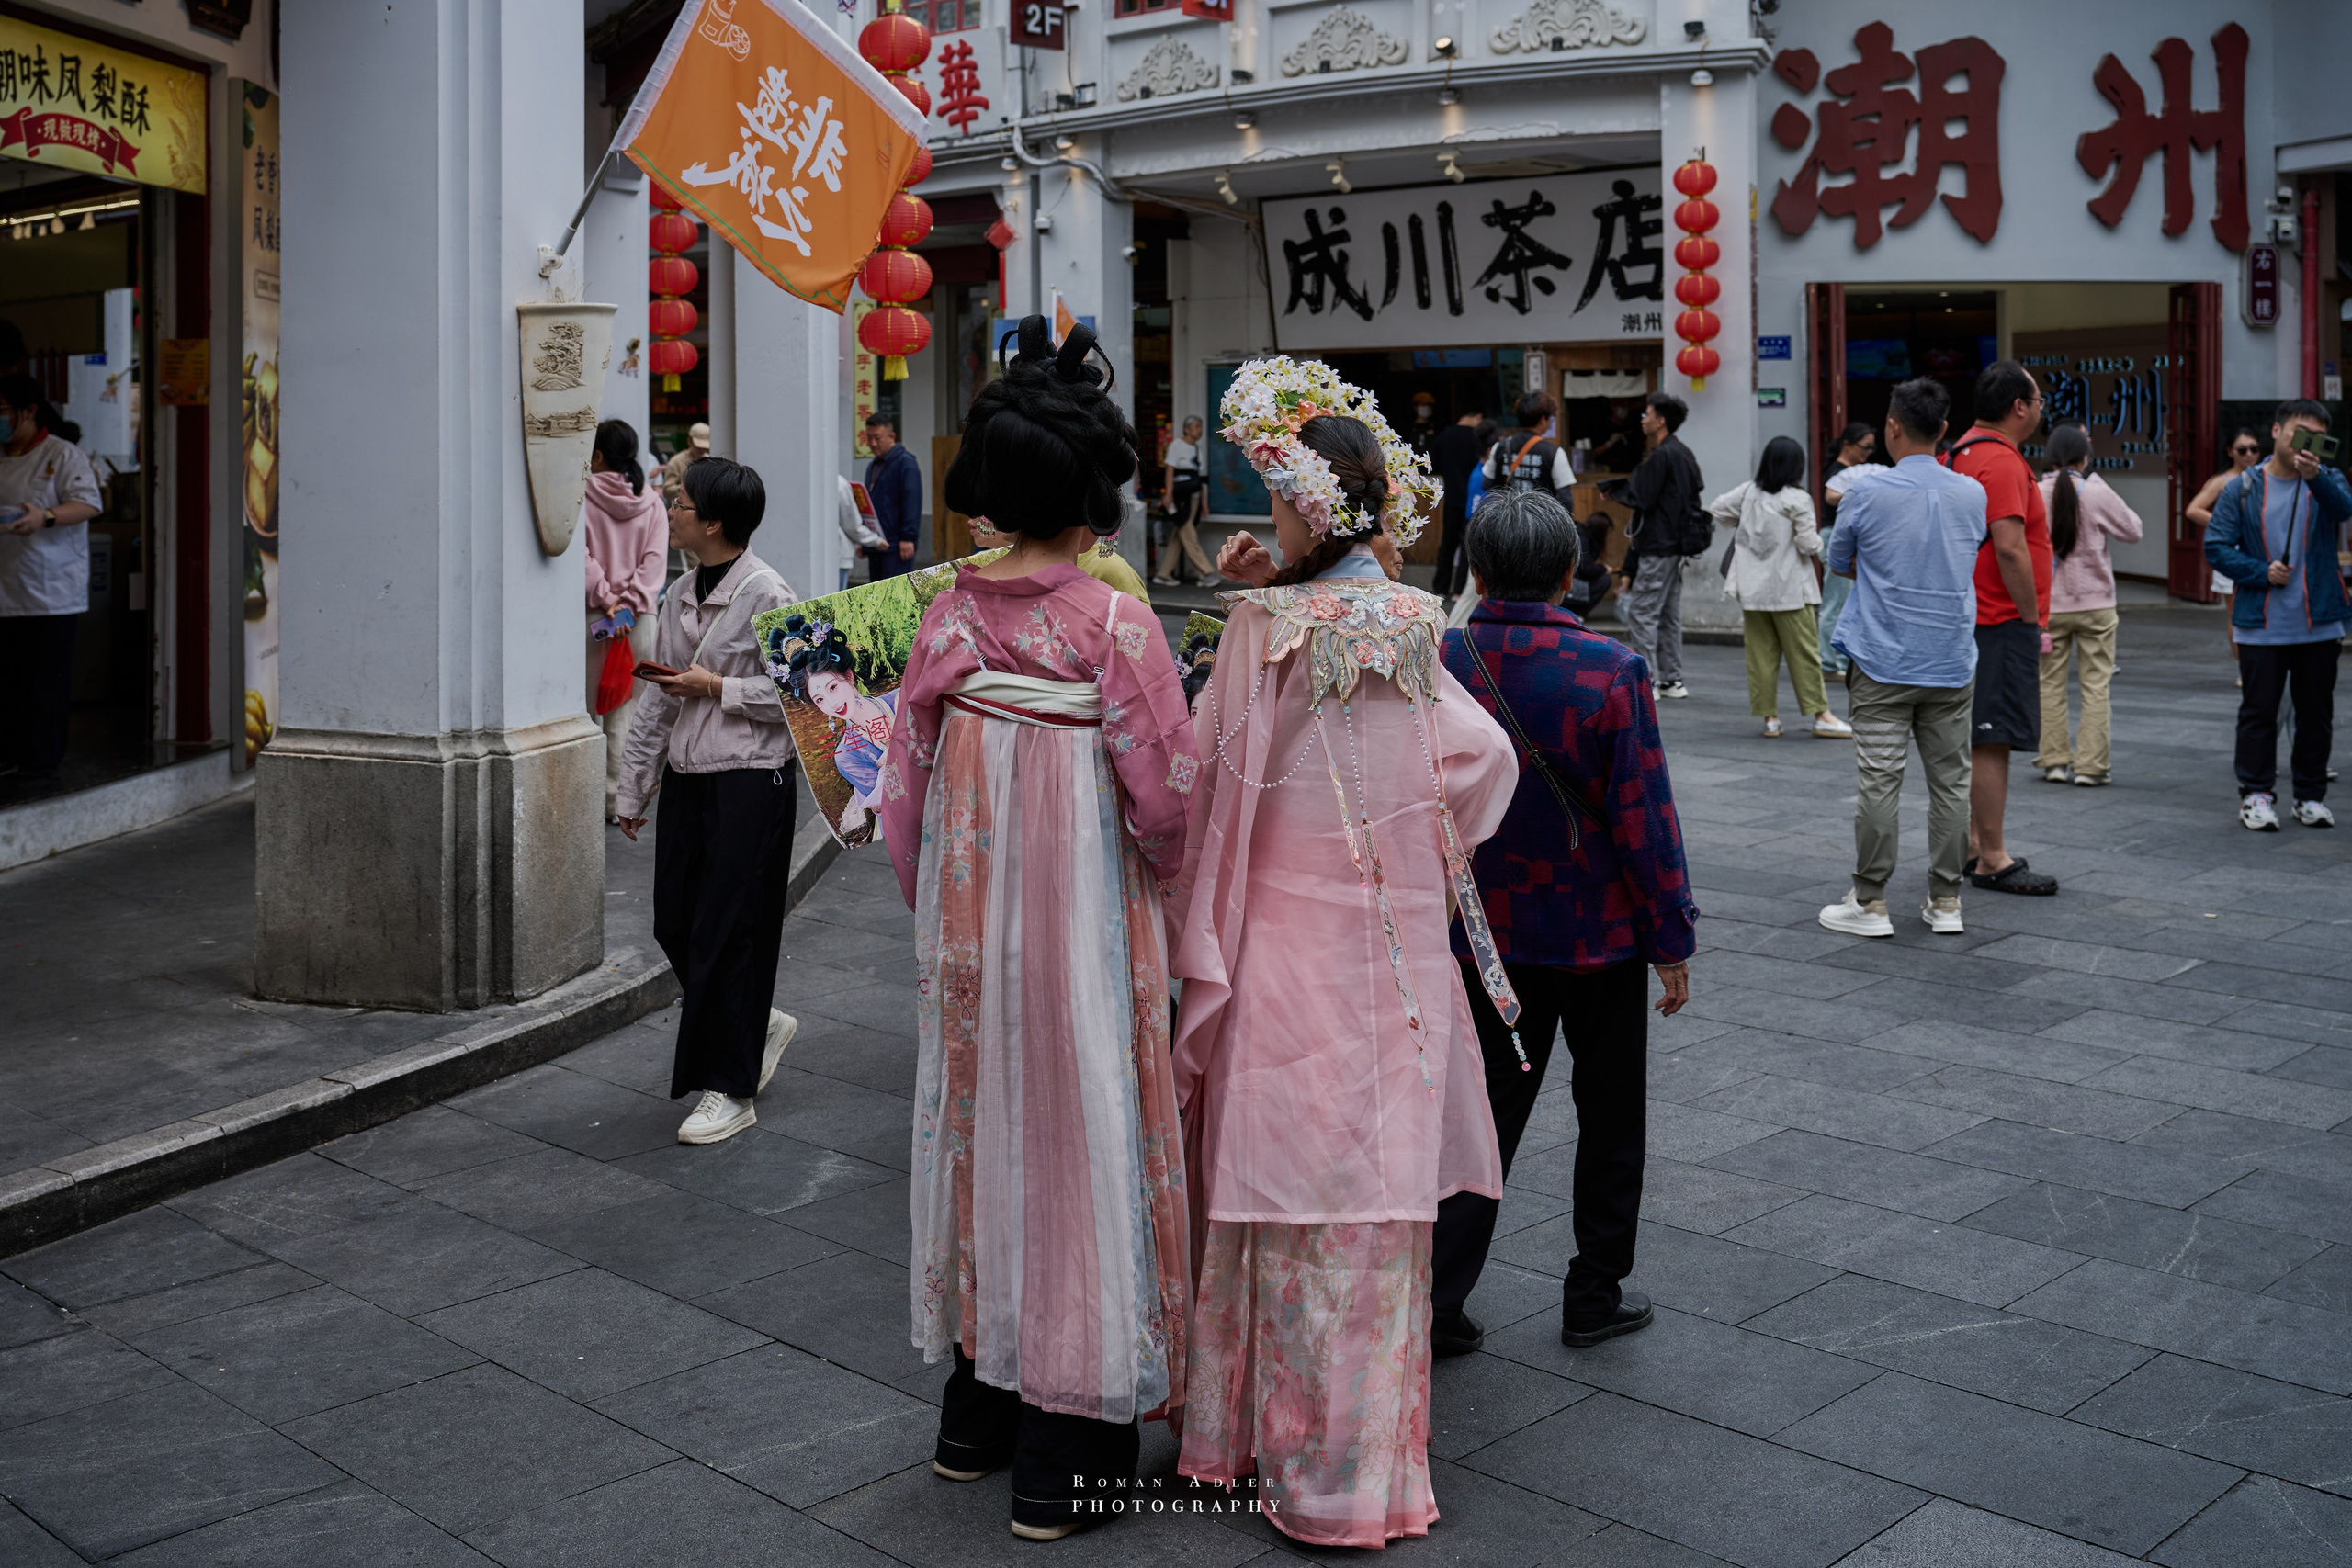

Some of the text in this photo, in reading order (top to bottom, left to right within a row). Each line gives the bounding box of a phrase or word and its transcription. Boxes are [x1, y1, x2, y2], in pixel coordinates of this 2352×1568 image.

[1026, 3, 1064, 36] 2F
[915, 38, 990, 137] 華
[43, 118, 101, 152] 现做现烤
[1770, 20, 2250, 252] 潮州
[1282, 179, 1664, 321] 成川茶店
[1622, 312, 1663, 333] 潮州
[815, 715, 892, 759] 三笙阁
